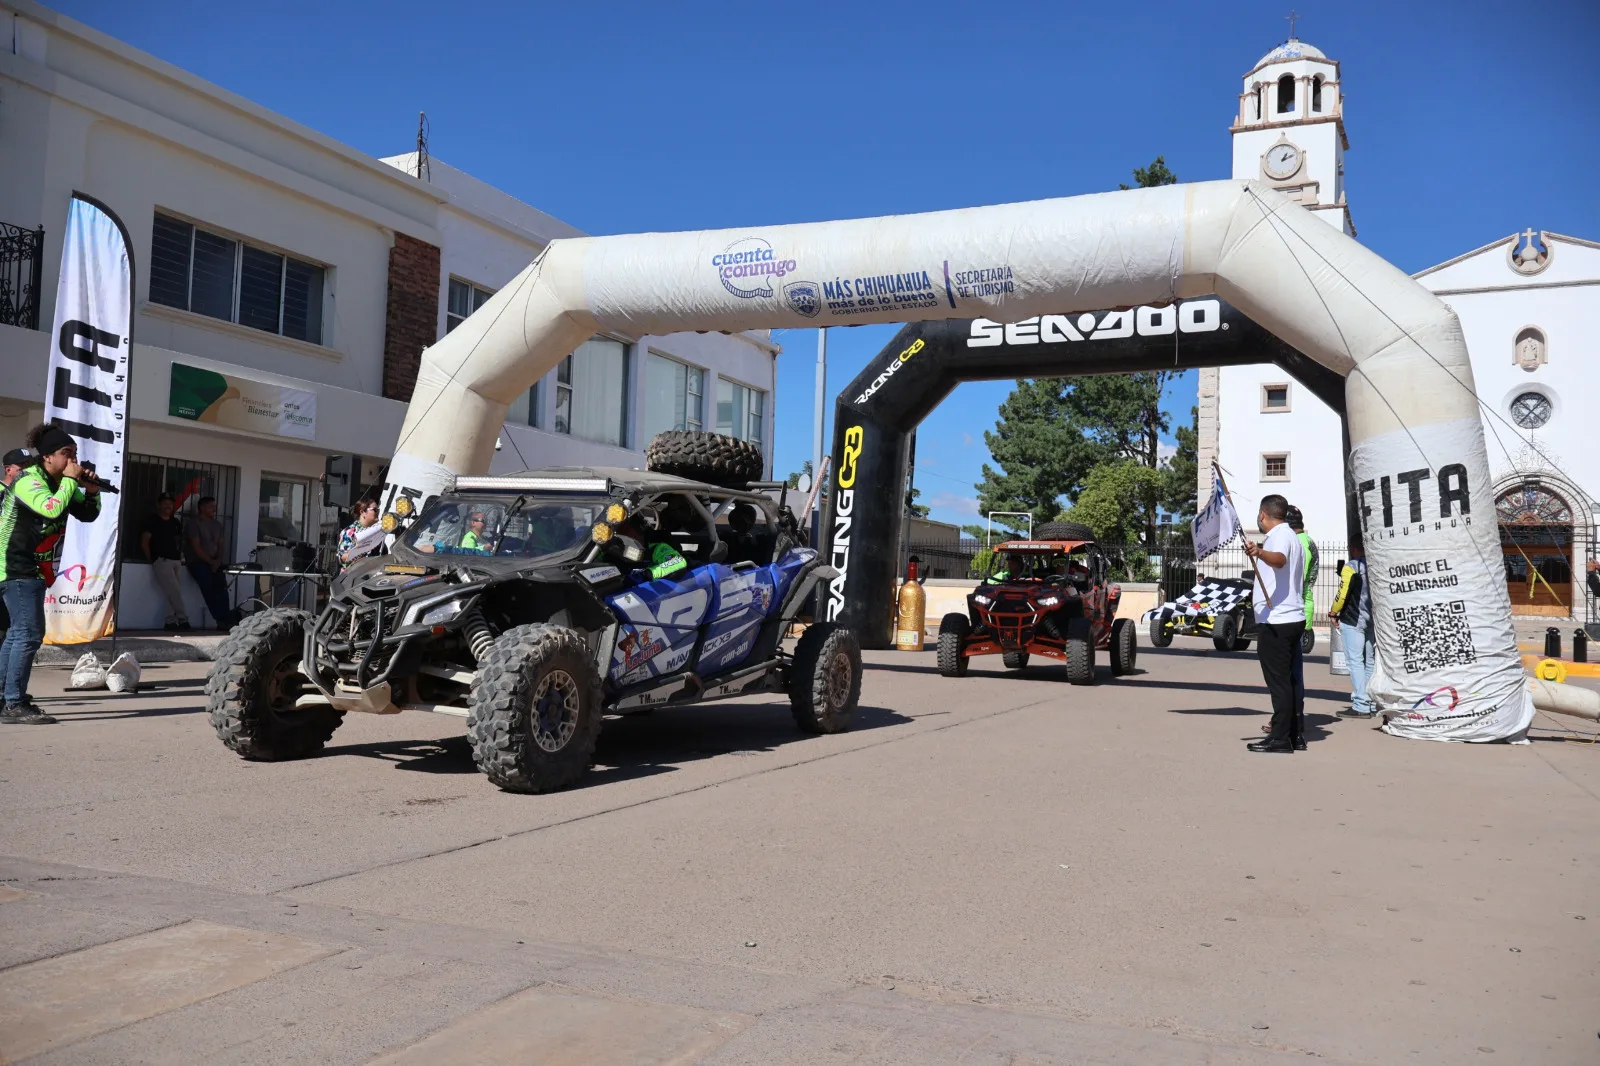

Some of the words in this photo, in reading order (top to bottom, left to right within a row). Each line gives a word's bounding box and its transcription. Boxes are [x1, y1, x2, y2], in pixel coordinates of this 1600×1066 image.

[712, 248, 773, 267] cuenta
[723, 259, 796, 279] conmigo
[955, 264, 1013, 286] SECRETARÍA
[823, 274, 853, 300] MÁS
[854, 271, 932, 296] CHIHUAHUA
[957, 286, 970, 298] DE
[972, 281, 1014, 298] TURISMO
[828, 296, 854, 309] más
[858, 295, 874, 307] de
[877, 294, 891, 305] lo
[894, 291, 935, 304] bueno
[832, 306, 880, 316] GOBIERNO
[882, 304, 899, 313] DEL
[902, 301, 938, 310] ESTADO
[51, 319, 120, 494] ITA
[1359, 463, 1471, 533] FITA
[827, 489, 855, 622] RACING
[1388, 561, 1433, 579] CONOCE
[1436, 559, 1453, 572] EL
[1389, 574, 1459, 595] CALENDARIO
[639, 693, 651, 704] TM
[719, 685, 729, 694] TM
